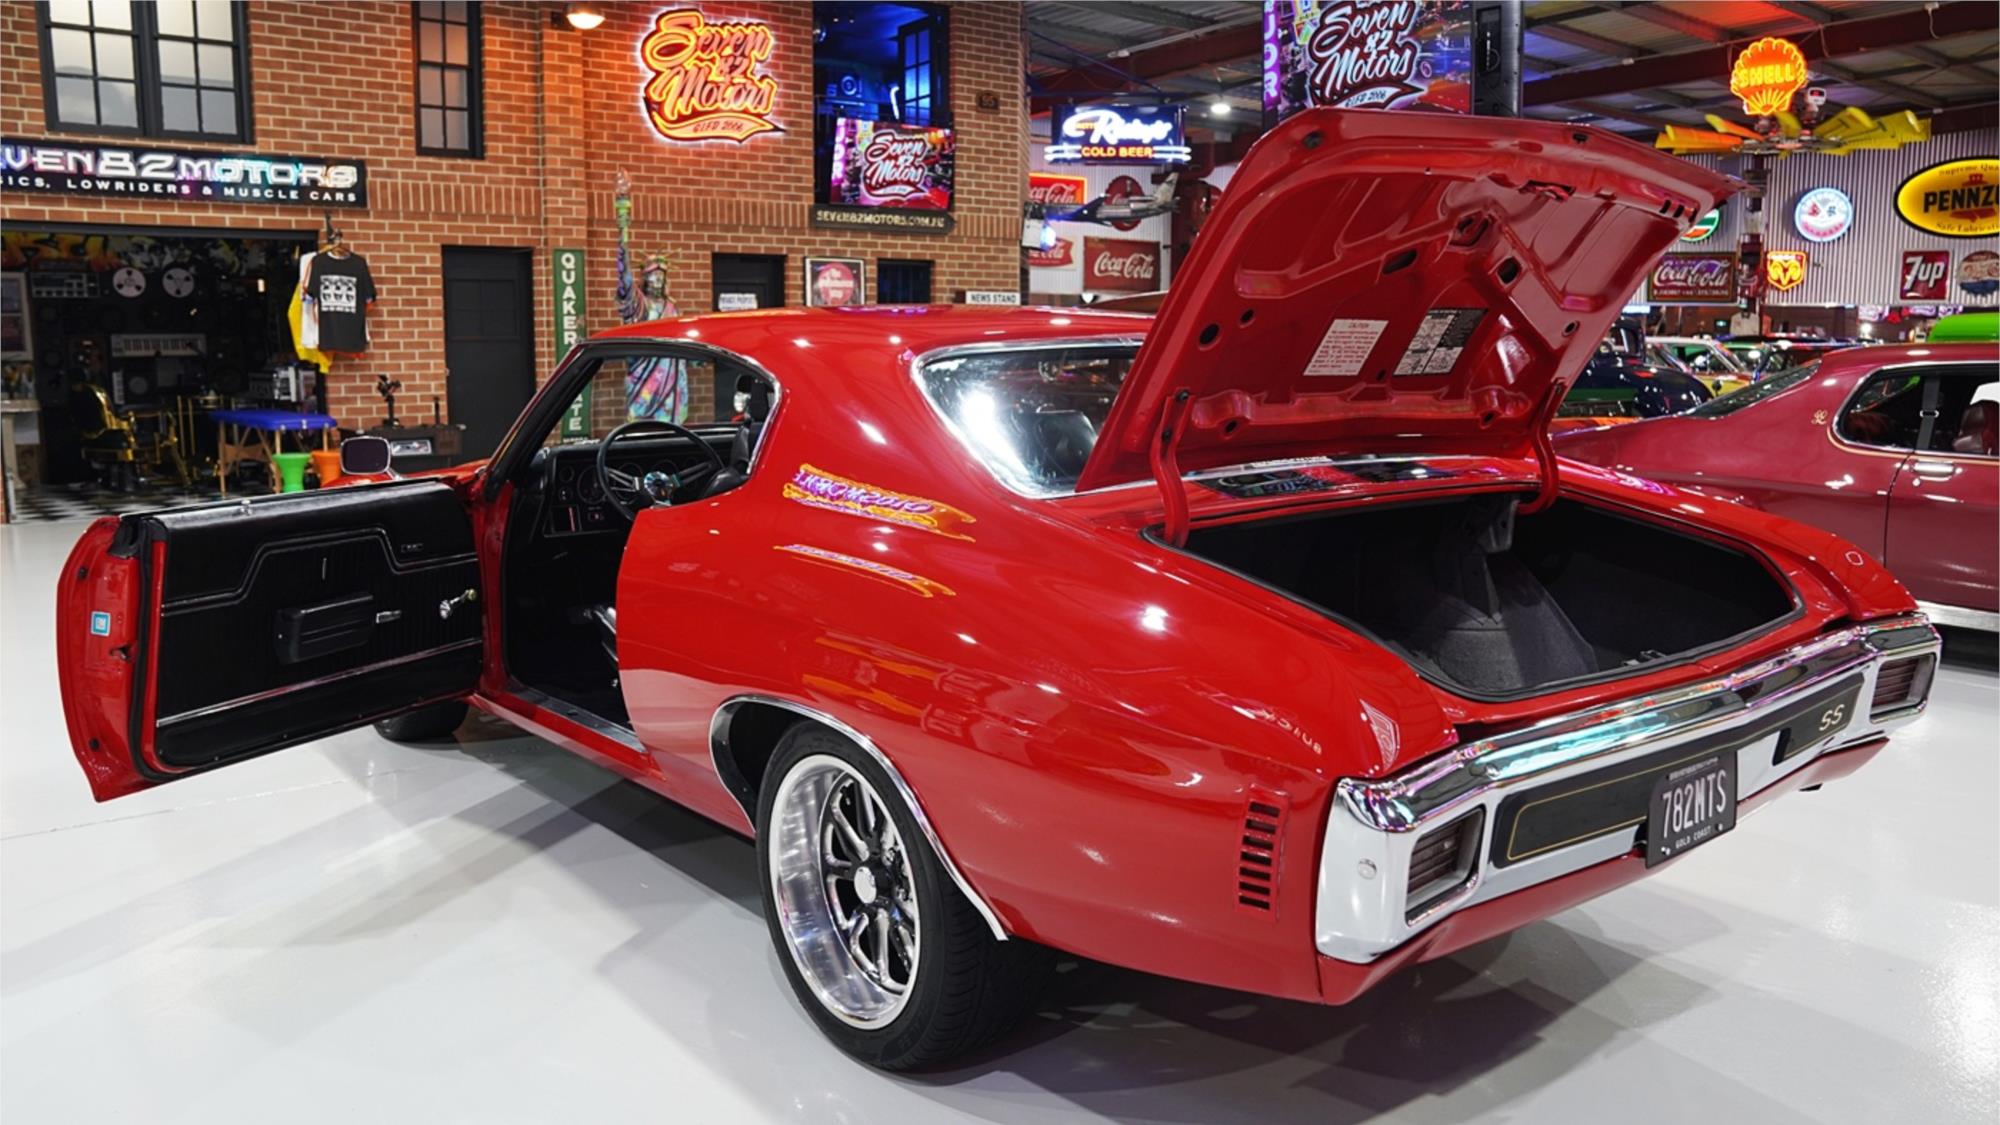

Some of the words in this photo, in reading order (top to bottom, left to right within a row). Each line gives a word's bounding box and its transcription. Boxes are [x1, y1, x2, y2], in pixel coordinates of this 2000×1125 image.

[646, 11, 774, 70] Seven
[1313, 1, 1407, 57] Seven
[1364, 30, 1392, 52] 82
[1315, 49, 1409, 98] Motors
[1740, 63, 1795, 88] SHELL
[650, 65, 778, 121] Motors
[866, 134, 926, 159] Seven
[1081, 147, 1116, 157] COLD
[1119, 147, 1153, 157] BEER
[866, 160, 925, 187] Motors
[67, 180, 191, 195] LOWRIDERS
[202, 187, 213, 195] &
[224, 187, 299, 199] MUSCLE
[309, 190, 357, 203] CARS
[1093, 251, 1154, 279] Coca-Cola
[1903, 255, 1946, 291] 7up
[561, 252, 577, 345] QUAKER
[970, 293, 991, 303] NEWS
[993, 293, 1017, 304] STAND
[1819, 703, 1845, 731] SS
